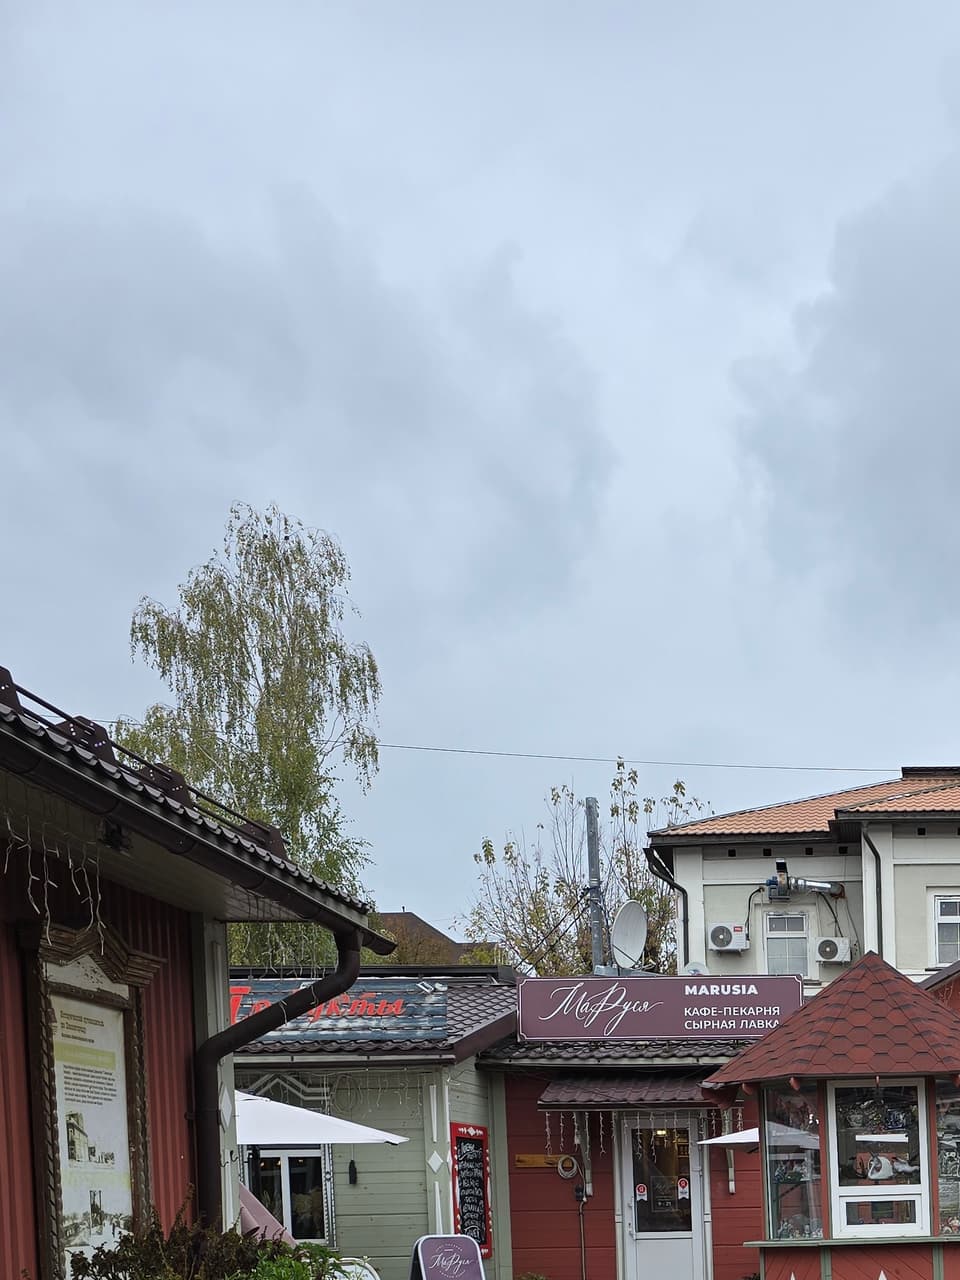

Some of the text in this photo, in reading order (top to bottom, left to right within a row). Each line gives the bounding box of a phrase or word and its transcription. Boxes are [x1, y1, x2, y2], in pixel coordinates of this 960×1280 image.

[684, 984, 759, 995] MARUSIA
[684, 1005, 781, 1017] КАФЕ-ПЕКАРНЯ
[684, 1018, 780, 1030] СЫРНАЯ ЛАВКА
